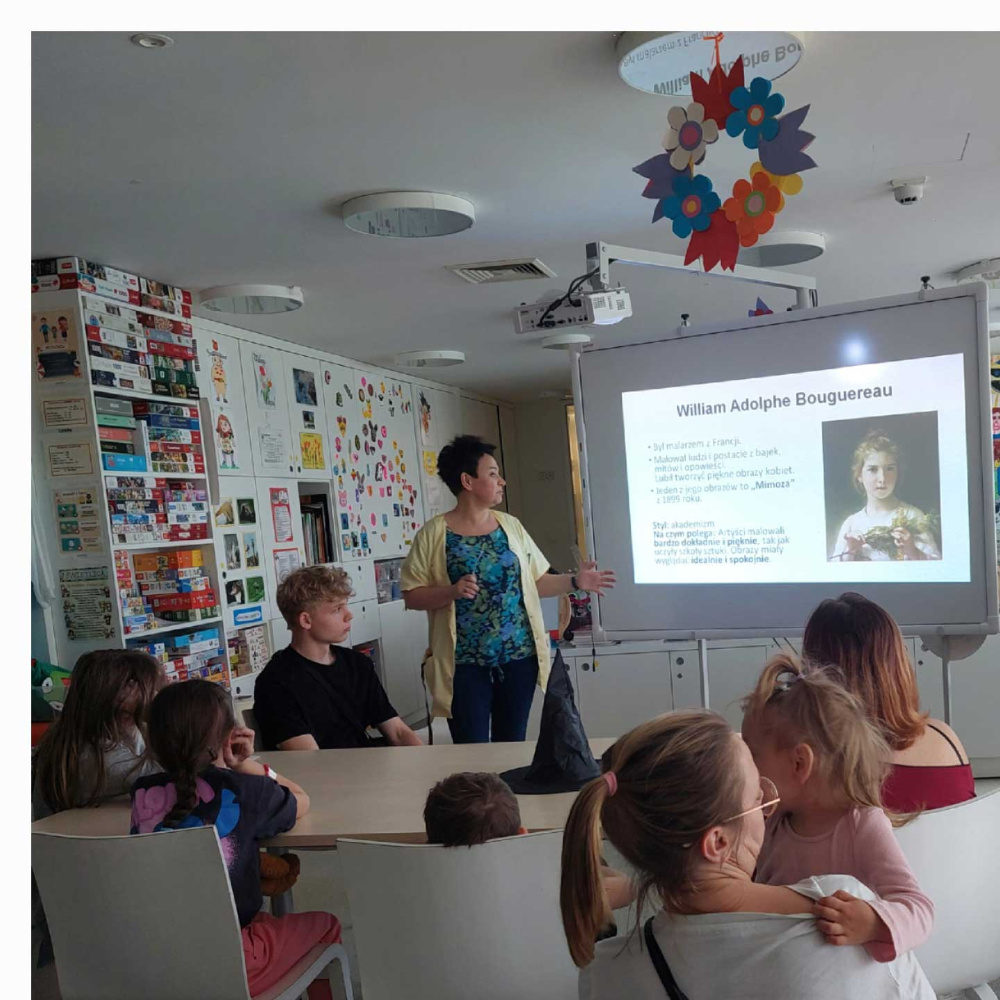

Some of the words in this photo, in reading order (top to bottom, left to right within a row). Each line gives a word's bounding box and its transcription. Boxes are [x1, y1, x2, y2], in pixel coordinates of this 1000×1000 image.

[676, 401, 726, 417] William
[730, 395, 791, 413] Adolphe
[795, 386, 893, 406] Bouguereau
[653, 442, 664, 452] Był
[666, 440, 704, 450] malarzem
[654, 454, 686, 464] Malował
[688, 452, 707, 461] ludzi
[714, 450, 747, 461] postacie
[707, 470, 734, 480] piękne
[736, 468, 763, 478] obrazy
[765, 466, 795, 476] kobiet.
[685, 485, 702, 494] jego
[704, 483, 738, 493] obrazów
[662, 495, 680, 504] 1899
[671, 520, 715, 529] akademizm
[748, 526, 785, 535] malowali
[654, 539, 680, 547] bardzo
[681, 538, 720, 546] dokładnie
[763, 536, 776, 544] tak
[777, 536, 790, 545] jak
[730, 545, 759, 555] Obrazy
[761, 545, 784, 555] miały
[691, 556, 722, 564] idealnie
